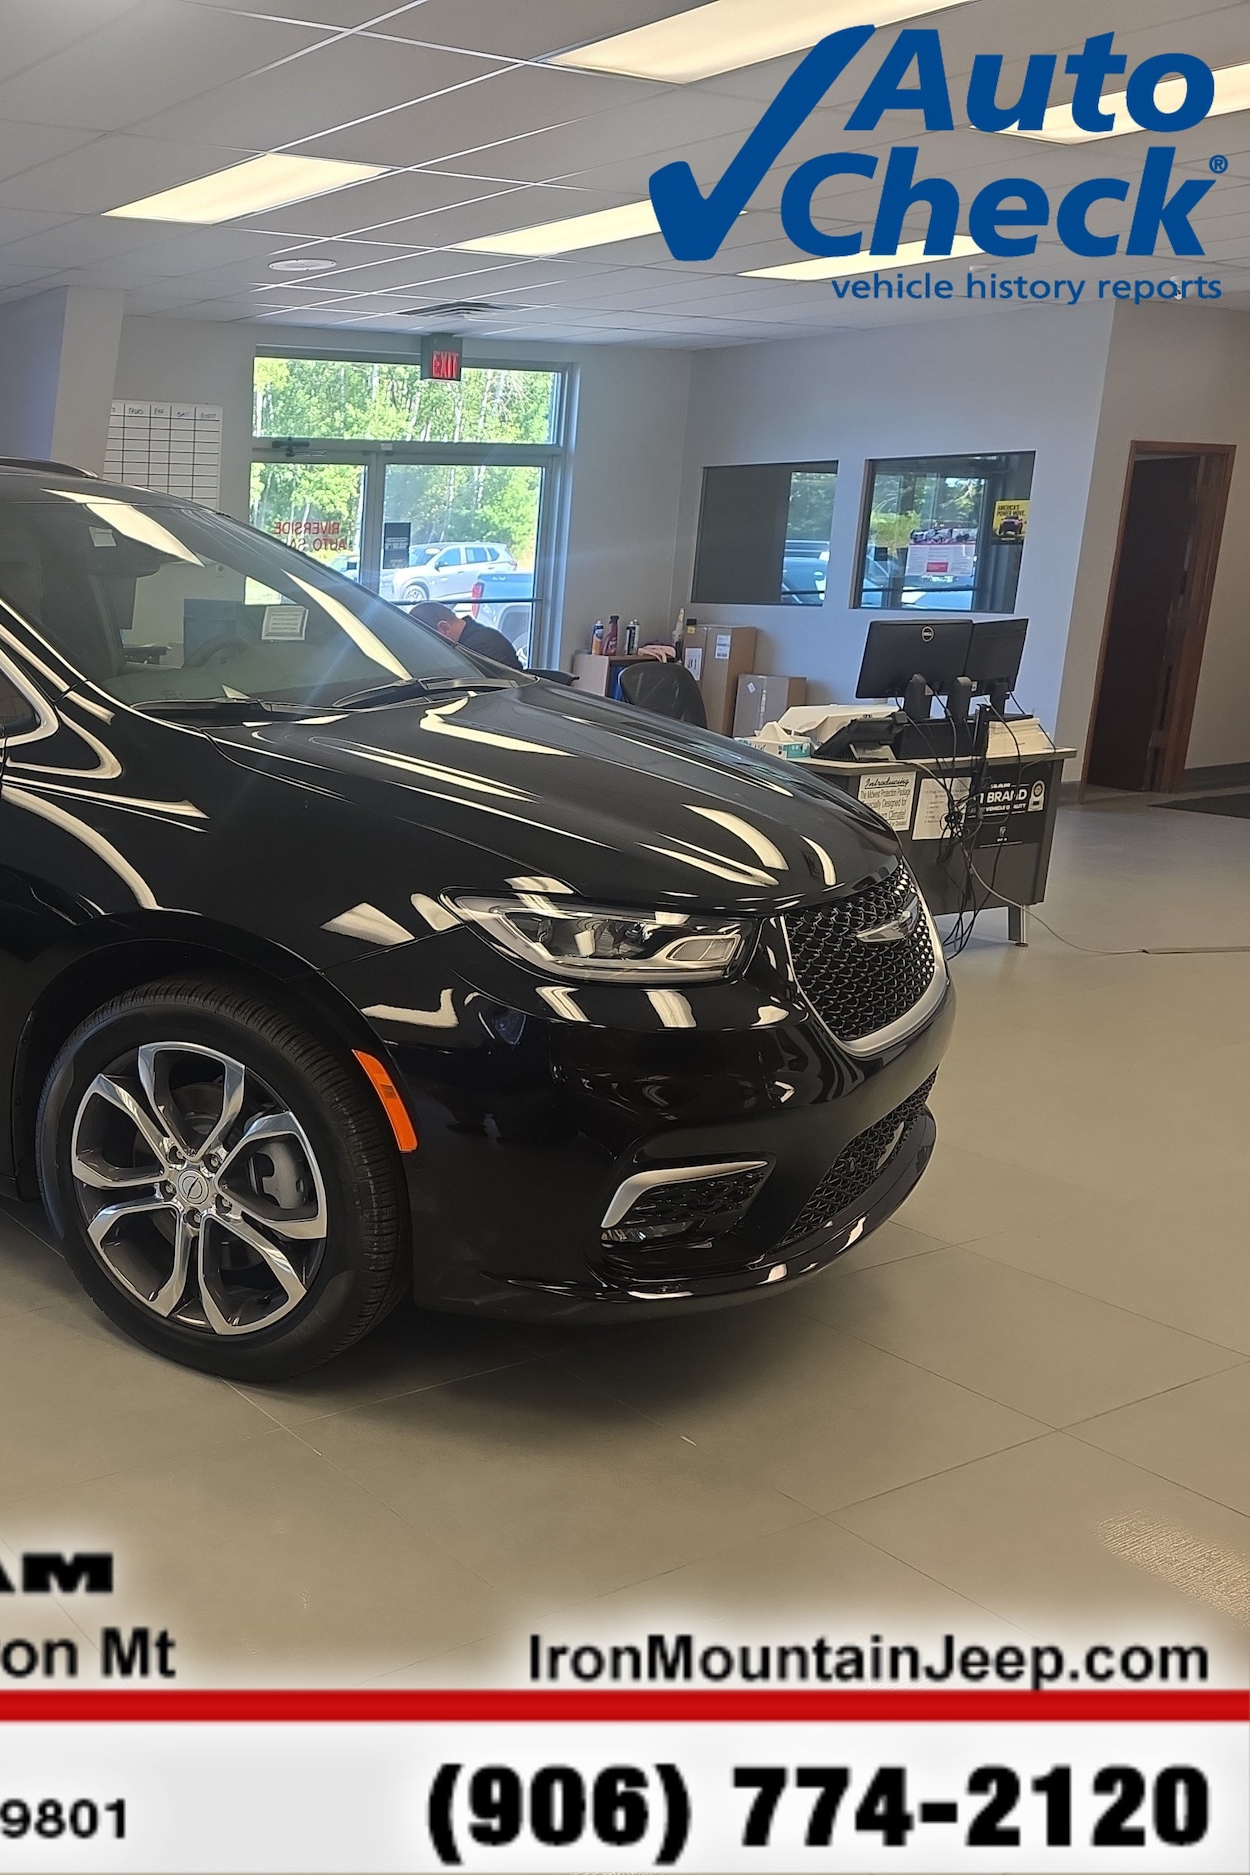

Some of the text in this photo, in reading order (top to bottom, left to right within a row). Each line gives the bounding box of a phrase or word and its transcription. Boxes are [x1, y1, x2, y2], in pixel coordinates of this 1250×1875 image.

[432, 350, 459, 378] EXIT
[864, 776, 910, 788] Introducing
[1005, 802, 1027, 811] QALITY
